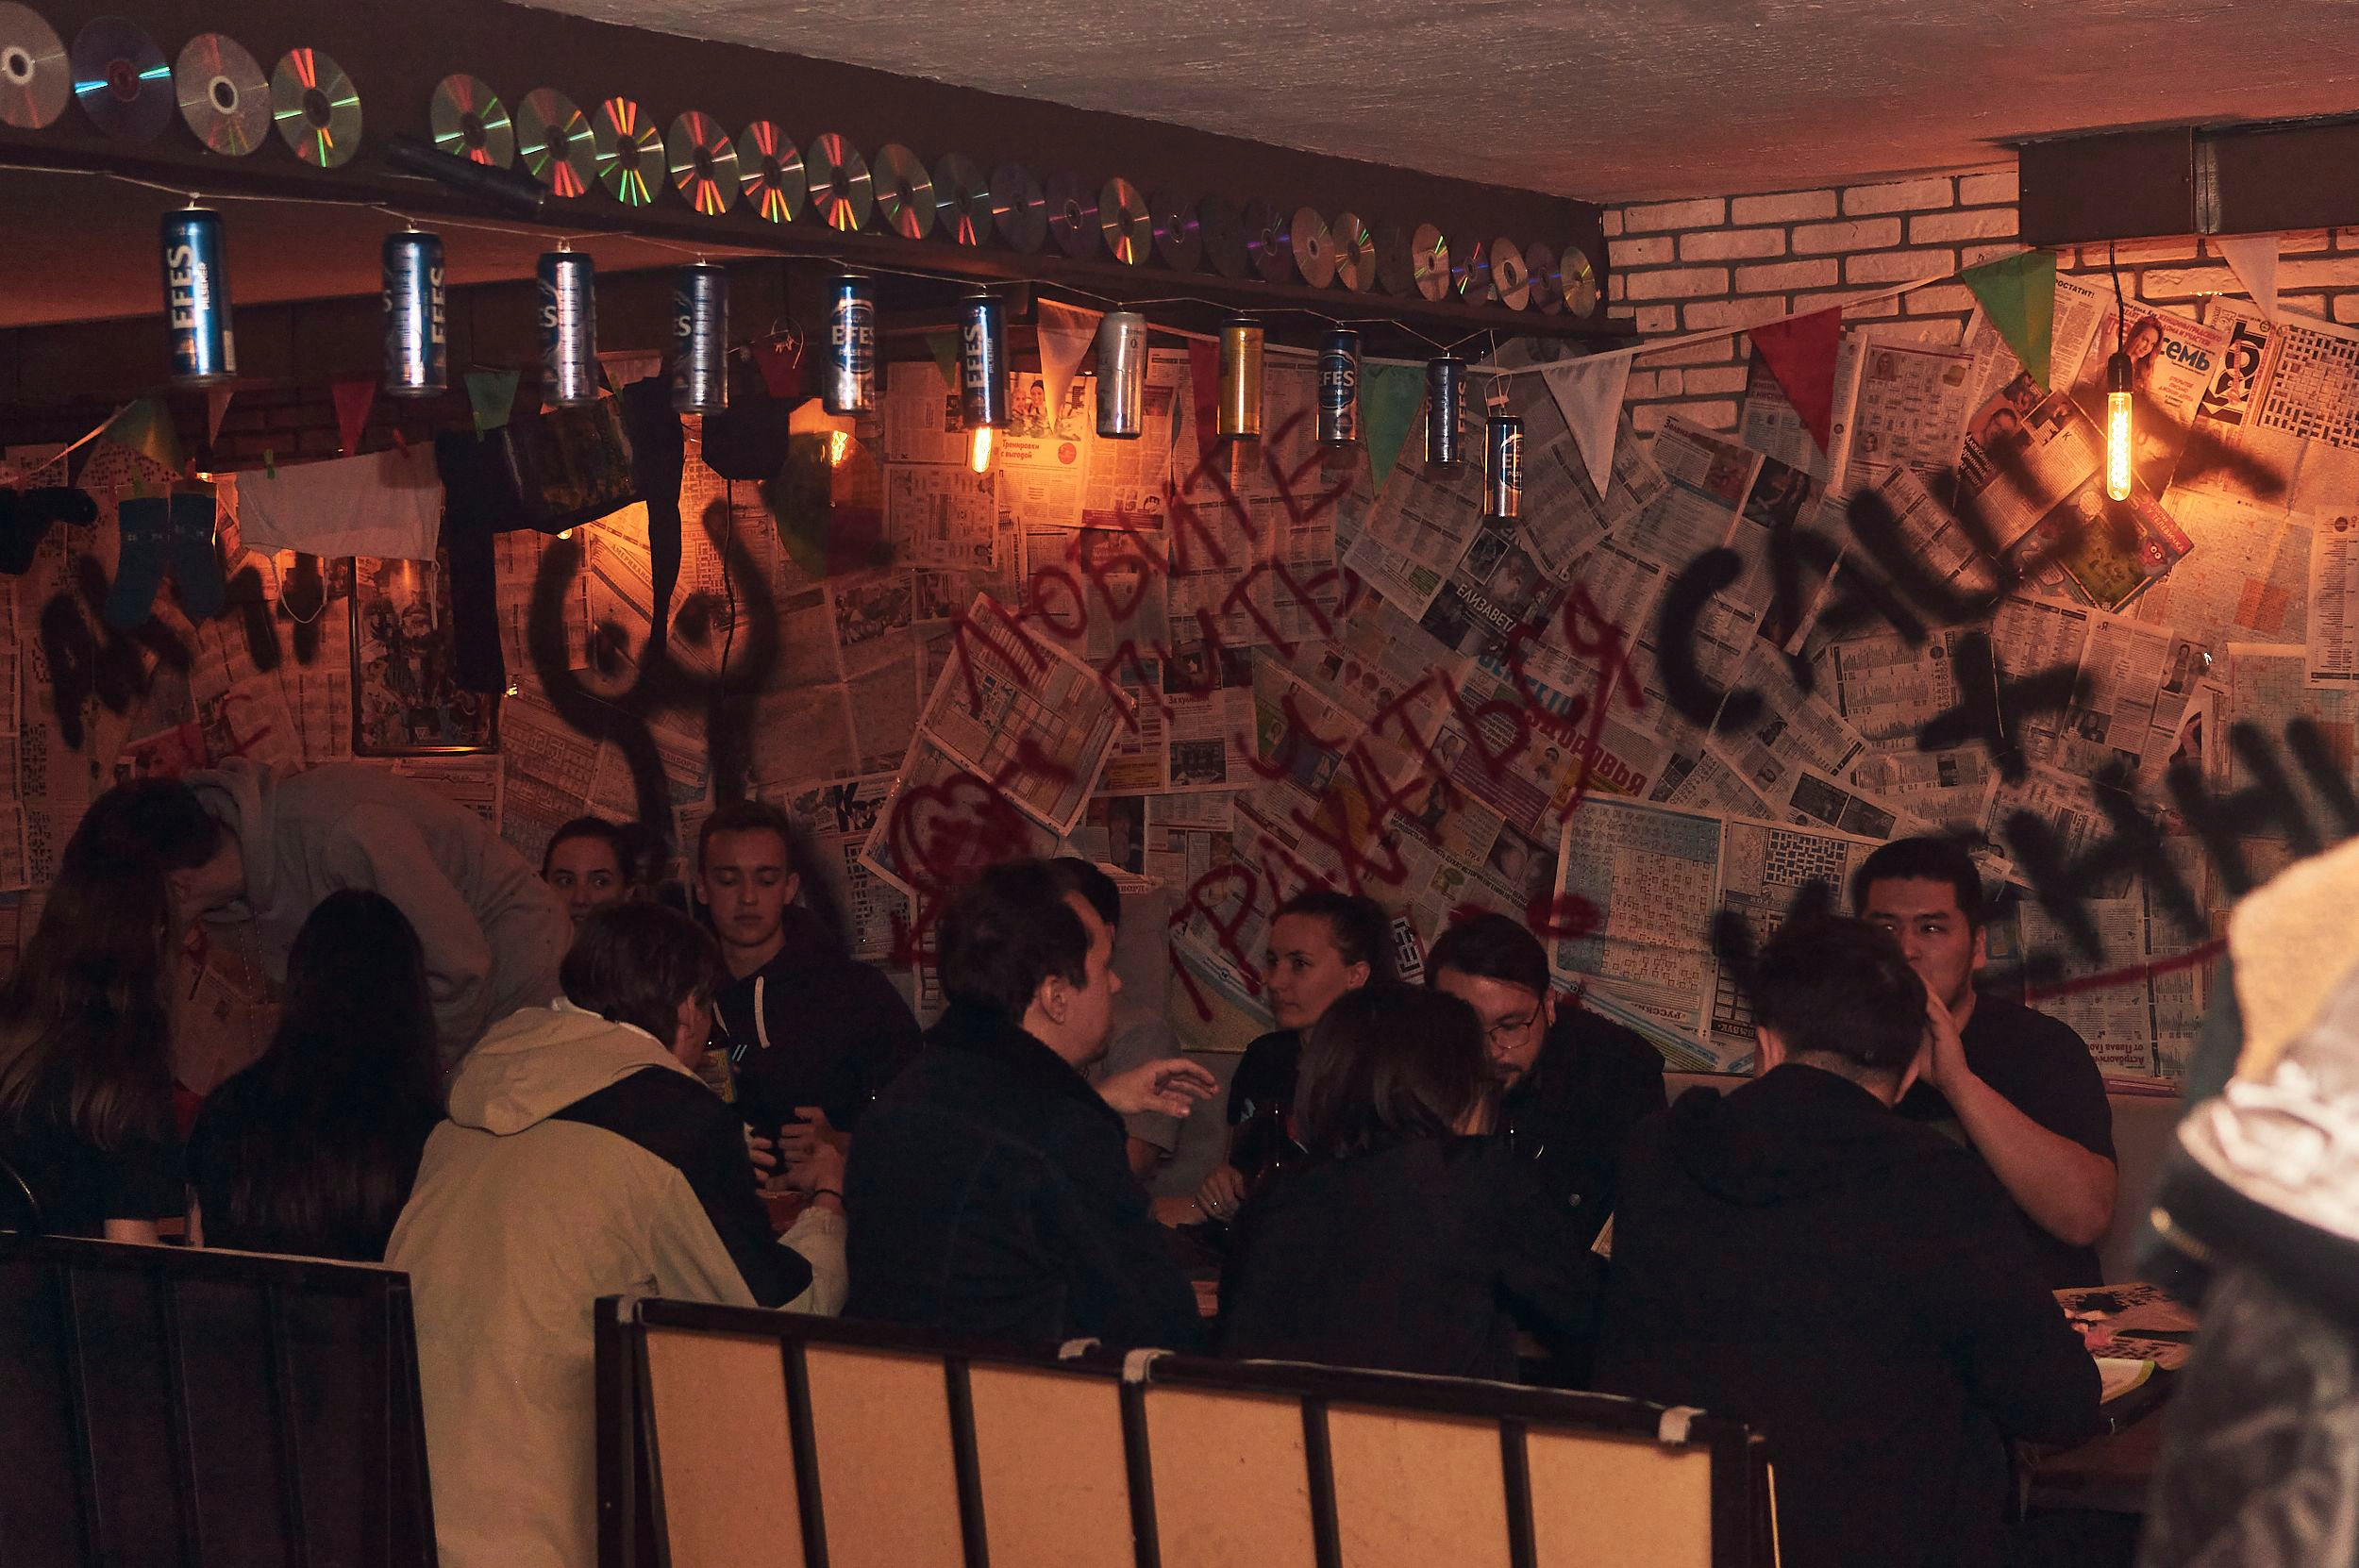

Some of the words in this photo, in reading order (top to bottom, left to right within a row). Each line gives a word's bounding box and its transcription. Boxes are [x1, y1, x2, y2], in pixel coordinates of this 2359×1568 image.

[167, 244, 195, 329] EFES
[430, 266, 447, 343] EFES
[964, 322, 984, 390] EFES
[1001, 440, 1039, 453] Тренировки
[1007, 448, 1032, 460] выгодой
